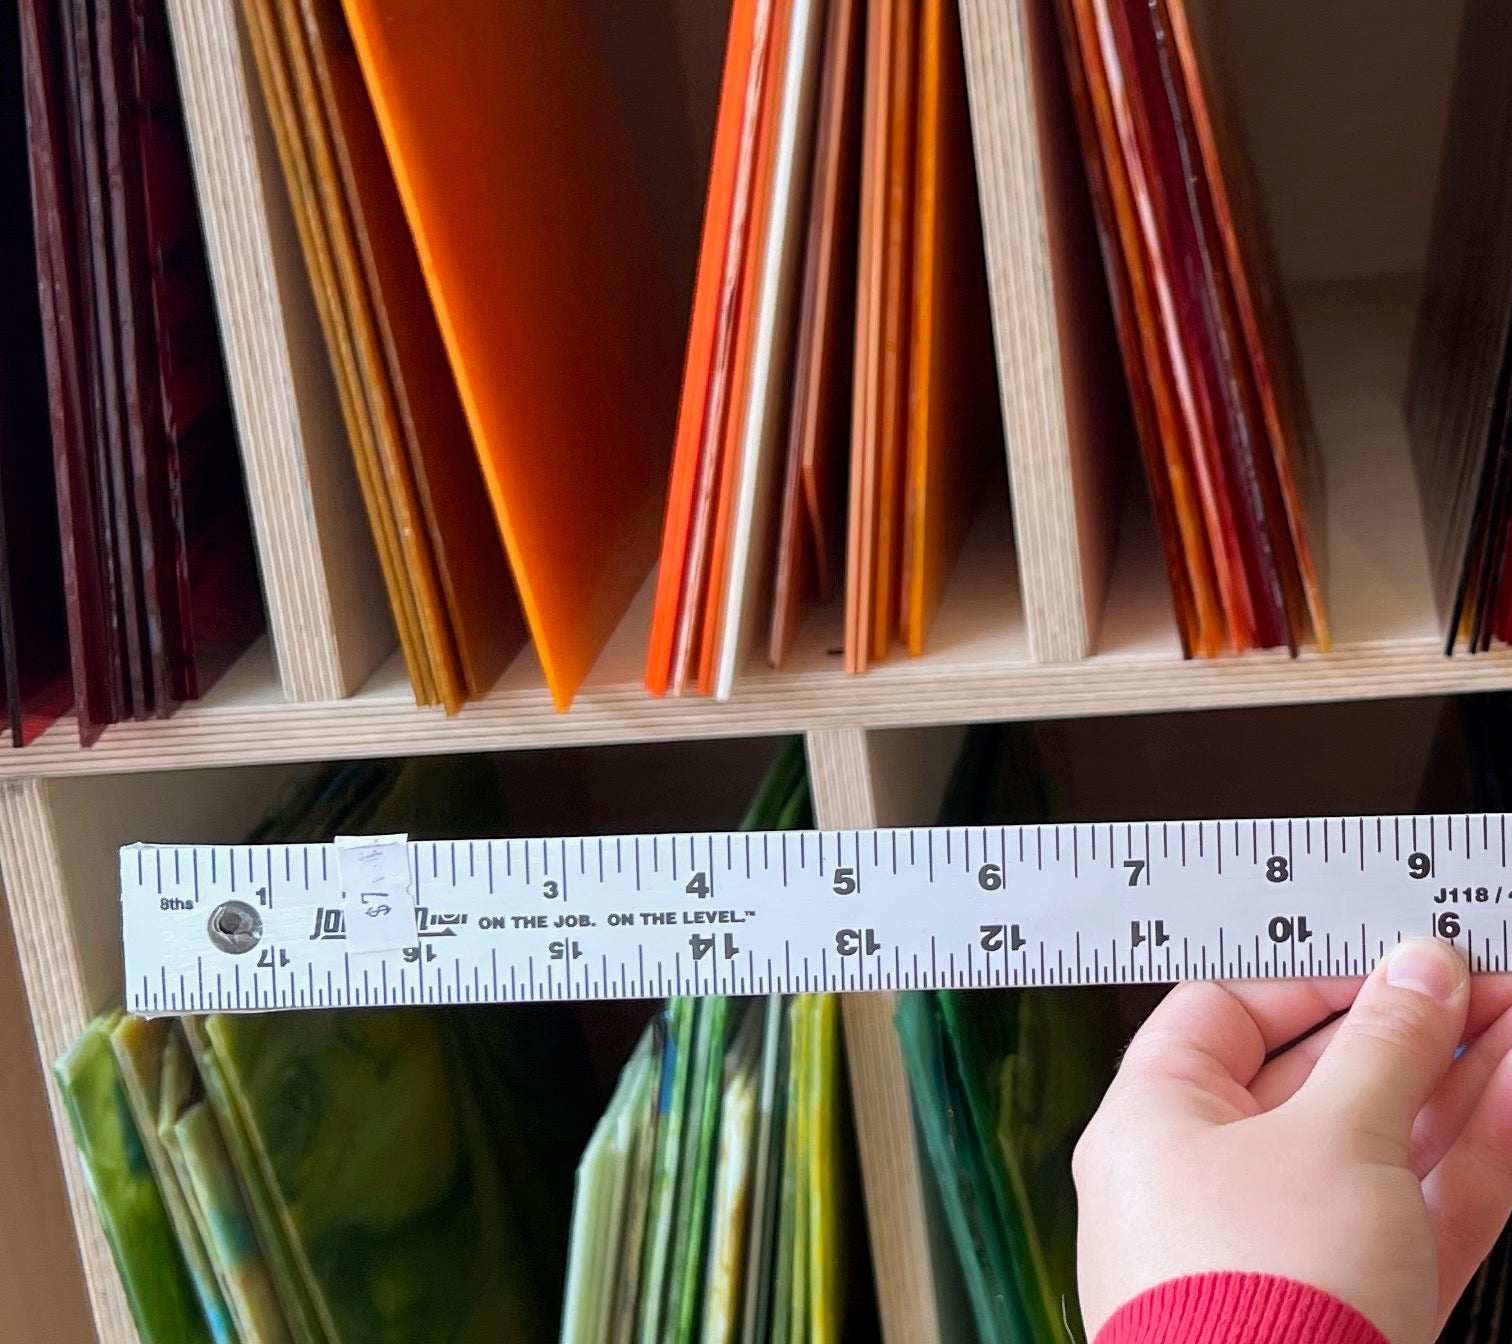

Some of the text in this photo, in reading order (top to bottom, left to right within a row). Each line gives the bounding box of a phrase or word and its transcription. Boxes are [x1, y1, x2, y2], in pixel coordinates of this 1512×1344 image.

[255, 887, 266, 905] 1
[543, 881, 559, 899] 3
[685, 872, 709, 899] 4
[832, 867, 856, 895] 5
[978, 864, 1002, 891] 6
[1123, 860, 1145, 886] 7
[1266, 856, 1289, 883] 8
[1408, 852, 1431, 879] 9
[160, 897, 194, 910] 8ths
[1434, 887, 1489, 904] J118
[1495, 886, 1502, 904] /
[478, 917, 505, 929] ON
[511, 916, 547, 928] THE
[554, 914, 596, 927] JOB.
[608, 913, 634, 926] ON
[640, 912, 677, 925] THE
[1268, 915, 1313, 943] 10
[835, 928, 881, 956] 13
[980, 924, 1026, 952] 12
[1131, 920, 1170, 947] 11
[402, 944, 436, 963] 16
[548, 941, 583, 959] 15
[689, 933, 740, 960] 14
[257, 949, 290, 968] 17
